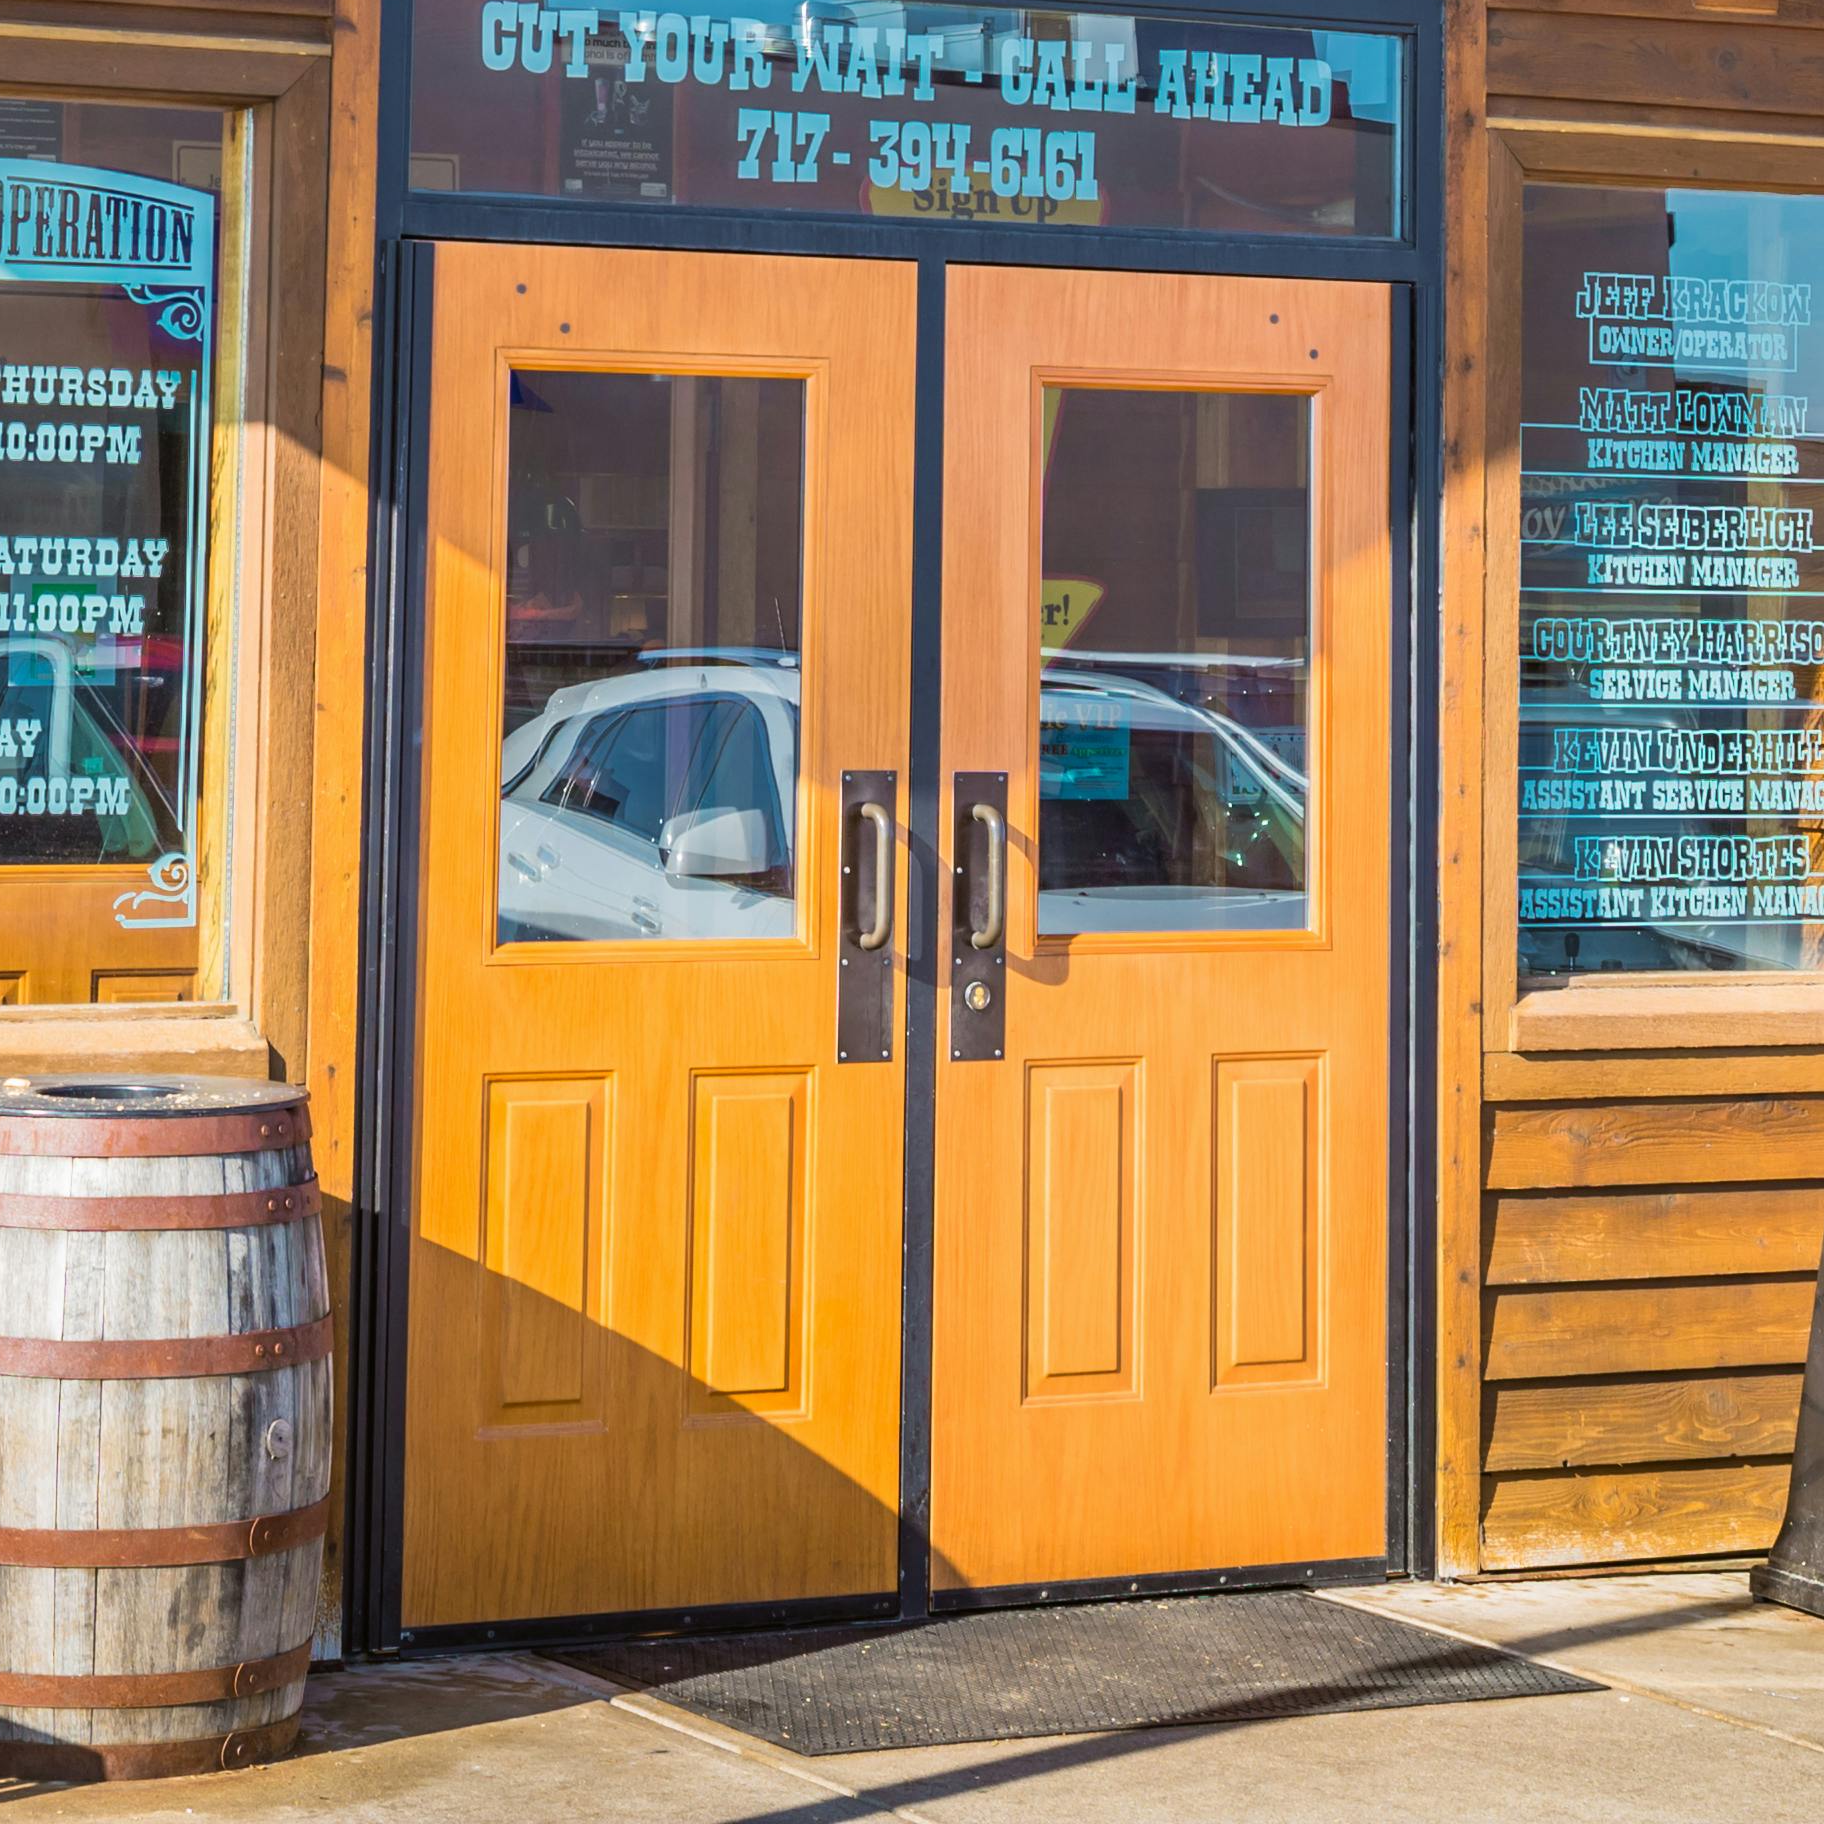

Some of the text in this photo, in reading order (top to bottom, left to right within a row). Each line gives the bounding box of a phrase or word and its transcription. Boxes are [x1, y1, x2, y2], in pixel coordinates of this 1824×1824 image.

[482, 0, 599, 78] CUT
[619, 9, 772, 90] YOUR
[792, 22, 944, 102] WAIT
[1001, 37, 1137, 114] CALL
[1154, 49, 1332, 127] AHEAD
[868, 119, 1099, 201] 394-6161
[1576, 272, 1811, 326] JEFF KRACKOW
[1599, 325, 1788, 362] OWNER/OPERATOR
[1579, 387, 1808, 439] MATT LOWMAN
[1587, 439, 1800, 475] KITCHEN MANAGER
[1575, 502, 1633, 549] LEE
[1638, 503, 1813, 554] SEIBERLICH
[1587, 554, 1799, 589] KITCHEN MANAGER
[1041, 593, 1070, 626] r!
[1533, 618, 1693, 664] COURTNEY
[1589, 669, 1796, 702] SERVICE MANAGER
[1553, 729, 1652, 774] KEVIN
[1522, 780, 1646, 812] ASSISTANT
[1652, 780, 1744, 812] SERVICE
[1575, 835, 1810, 883] KEVIN SHORTES
[1519, 887, 1646, 920] ASSISTANT
[1650, 886, 1748, 918] KITCHEN
